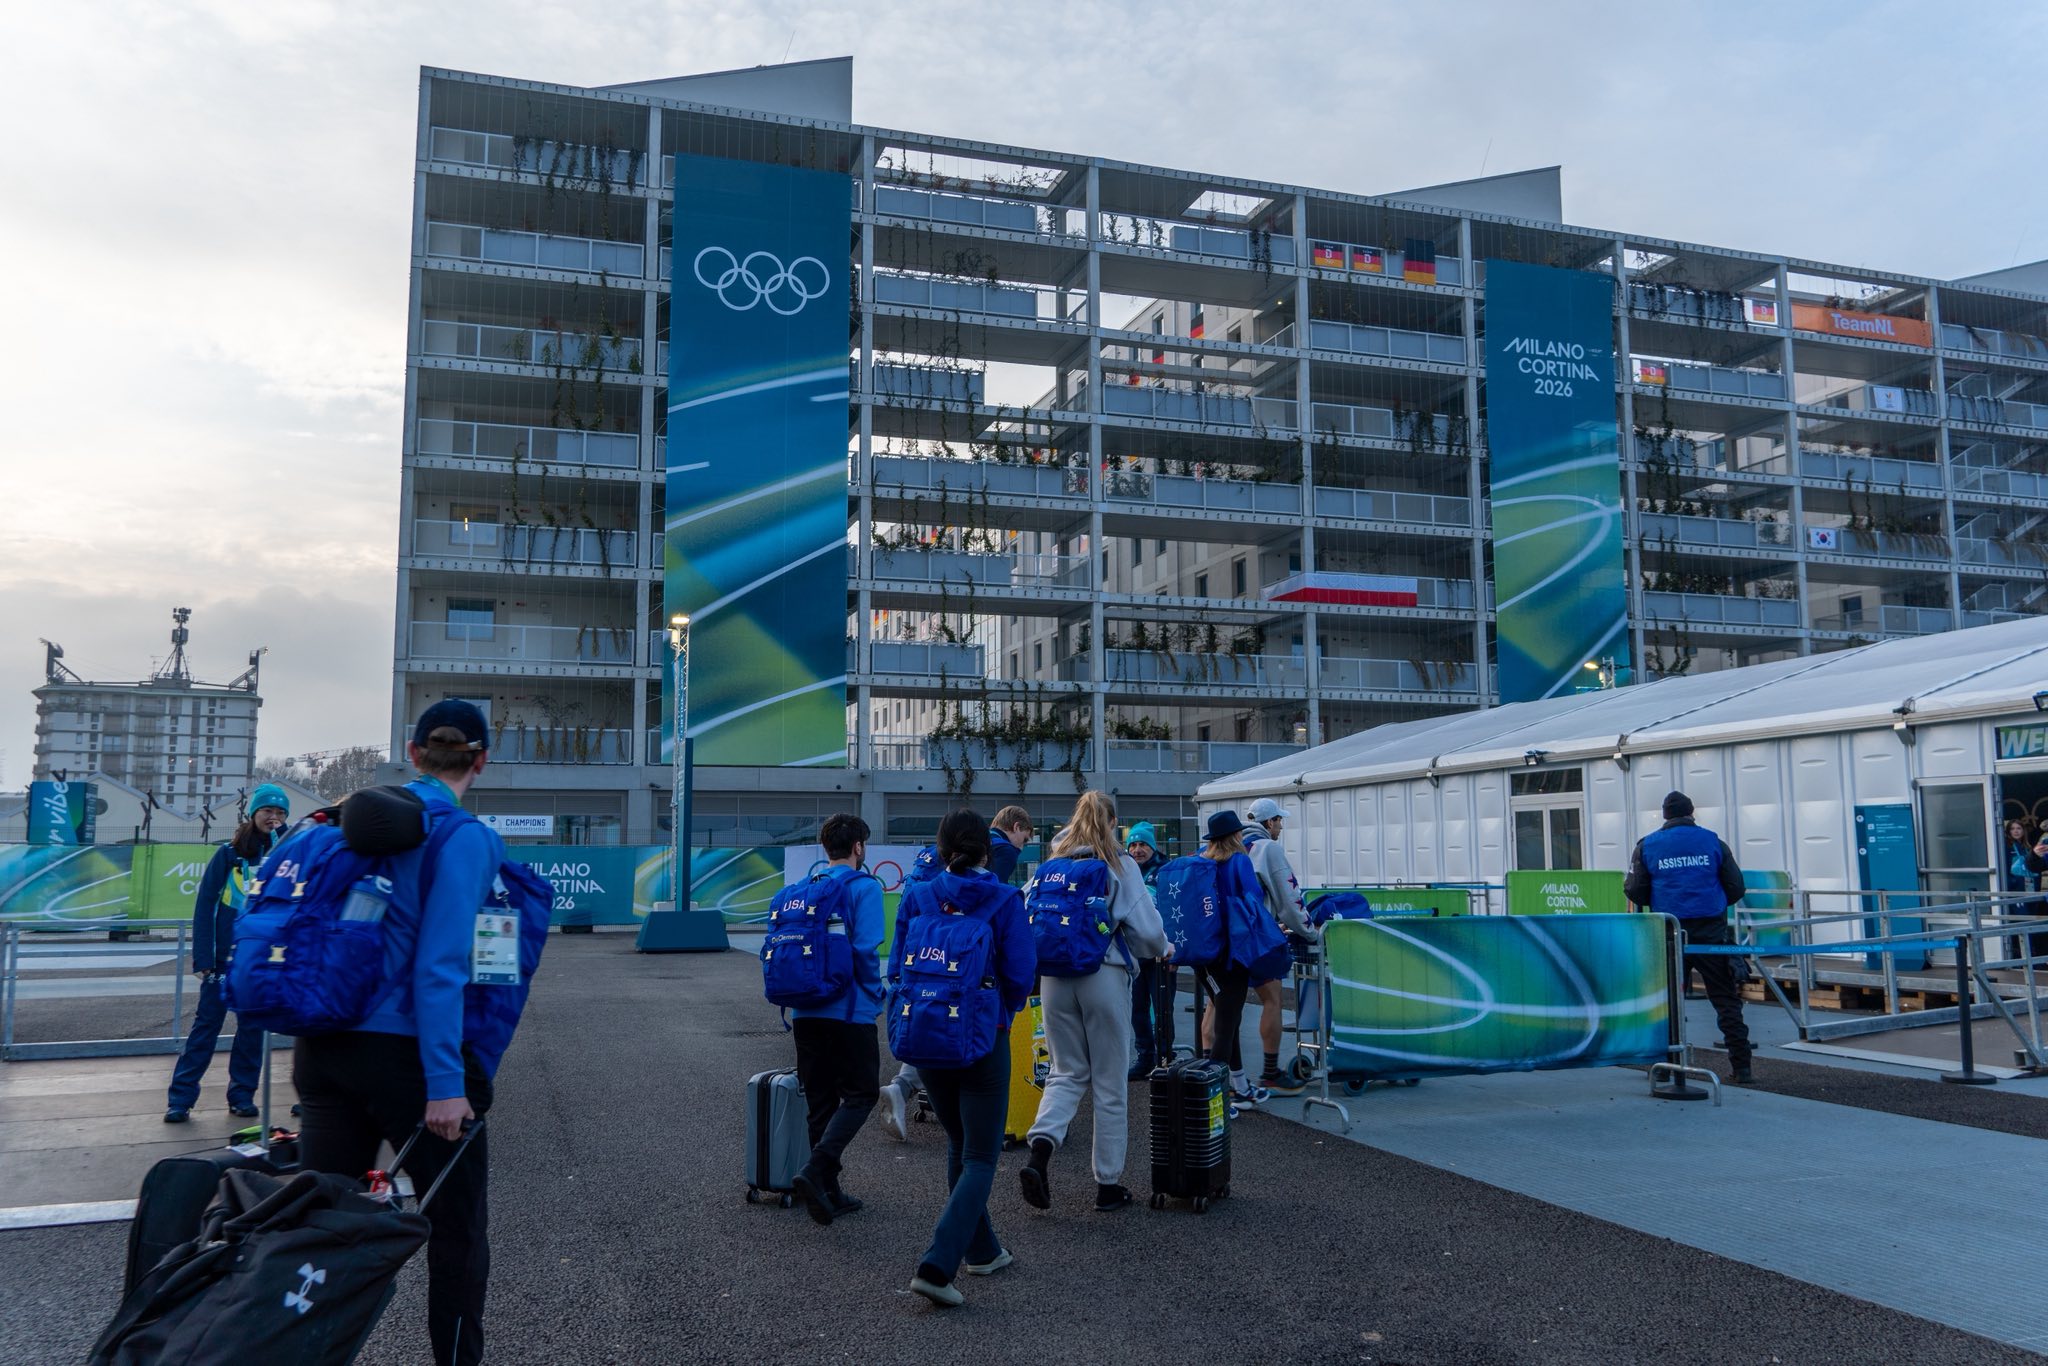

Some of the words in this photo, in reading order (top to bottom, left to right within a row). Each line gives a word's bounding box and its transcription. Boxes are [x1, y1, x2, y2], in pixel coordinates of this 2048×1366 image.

[1830, 312, 1896, 337] TeamNL
[1502, 337, 1585, 360] MILANO
[1518, 357, 1601, 382] CORTINA
[1534, 378, 1574, 397] 2026
[2000, 728, 2048, 757] WE
[43, 782, 69, 824] vibe
[505, 818, 546, 827] CHAMPIONS
[163, 862, 206, 877] MIL
[529, 862, 591, 877] ILANO
[1658, 855, 1711, 870] ASSISTANCE
[275, 860, 300, 883] SA
[1044, 872, 1066, 885] USA
[549, 879, 606, 894] RTINA
[1540, 883, 1579, 895] MILANO
[551, 896, 575, 910] 26
[783, 899, 805, 912] USA
[1203, 896, 1214, 918] USA
[1546, 895, 1588, 908] CORTINA
[919, 947, 946, 964] USA
[921, 989, 938, 997] Euni
